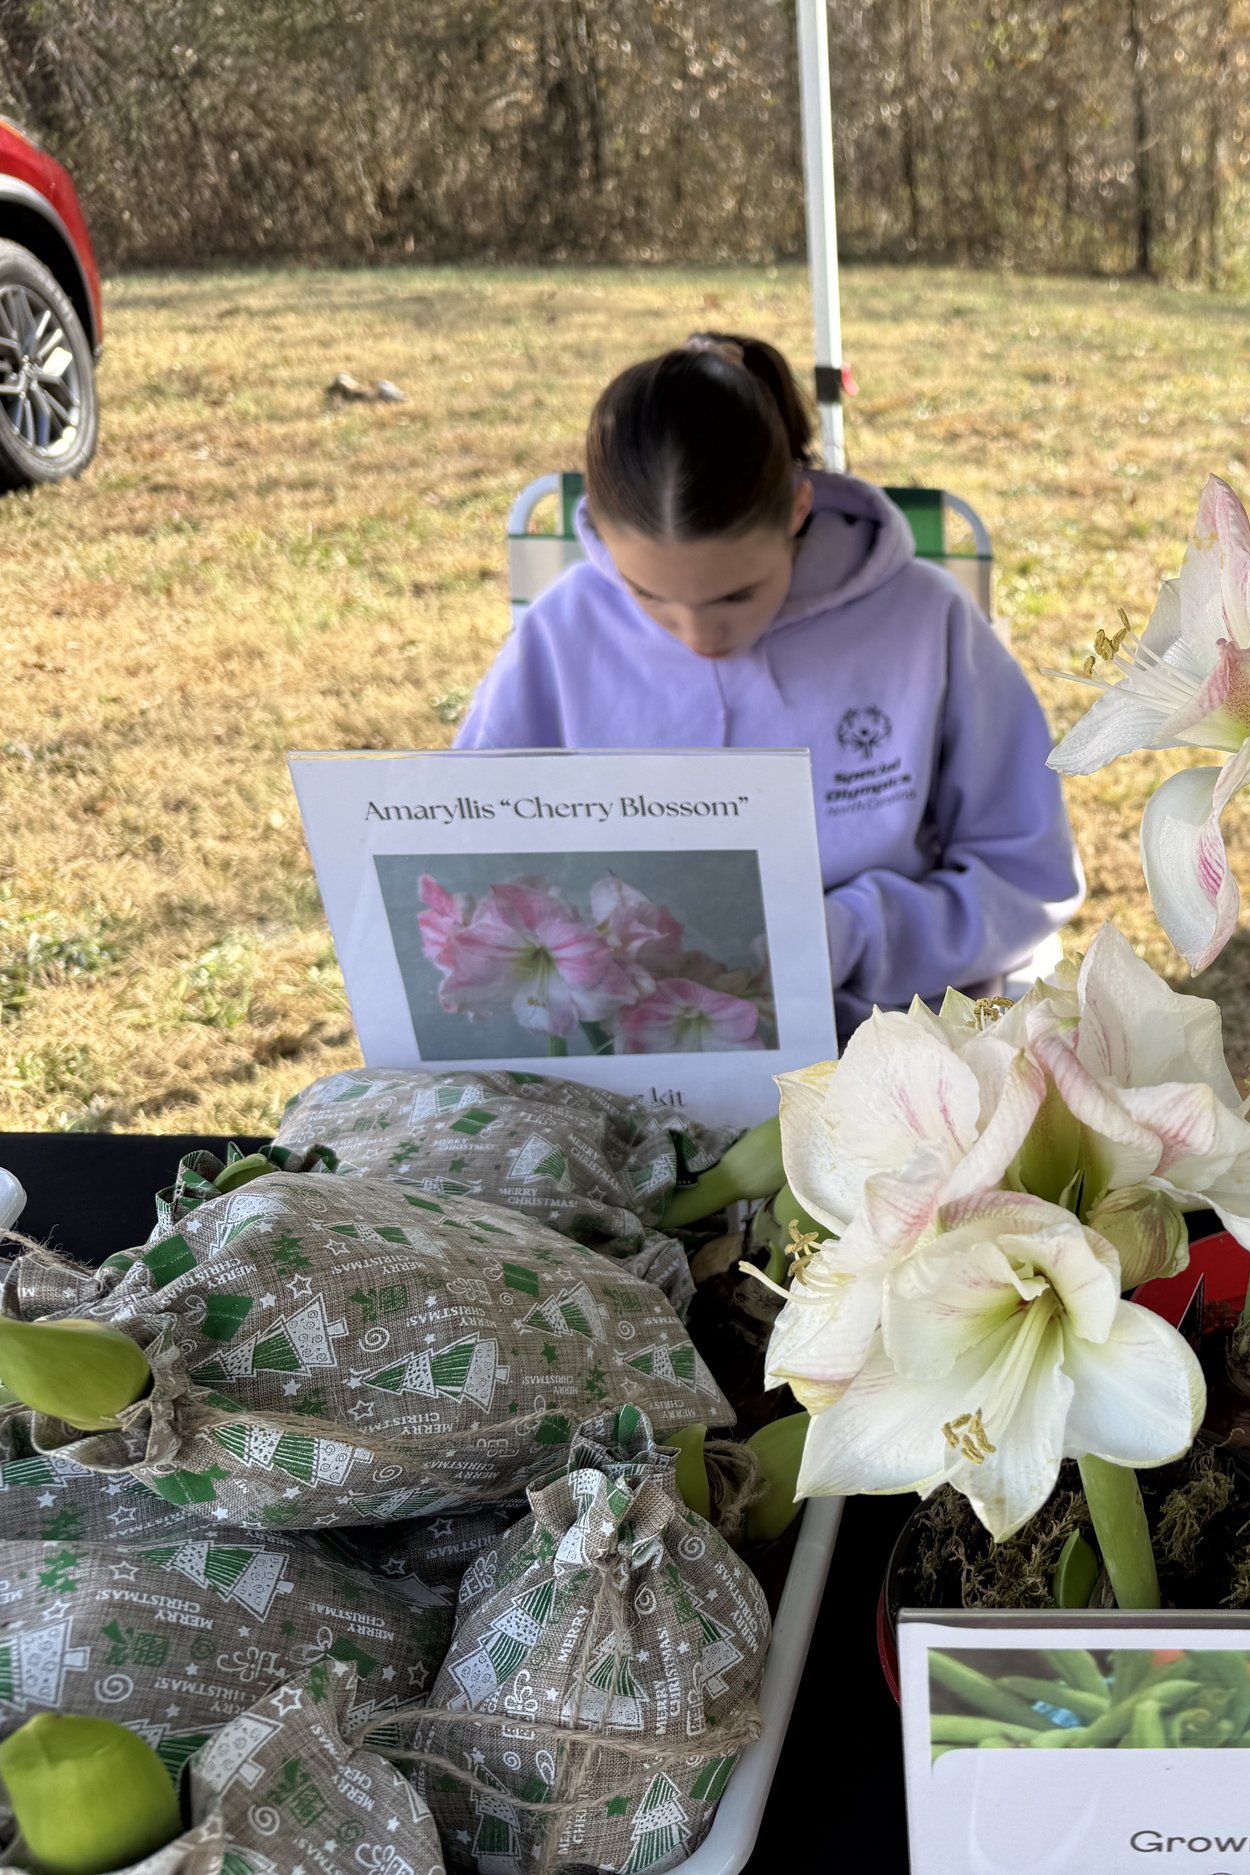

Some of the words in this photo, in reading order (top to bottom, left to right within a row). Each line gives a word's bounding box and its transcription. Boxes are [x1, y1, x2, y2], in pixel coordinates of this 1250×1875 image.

[366, 797, 495, 824] Amaryllis
[498, 1187, 539, 1198] MERRY
[507, 1196, 578, 1209] CHRISTMAS!
[331, 1254, 410, 1275] CHRISTMAS!
[382, 1260, 426, 1275] MERRY
[208, 1263, 258, 1290] MERRY
[405, 1306, 486, 1328] CHRISTMAS!
[459, 1315, 498, 1328] MERRY
[401, 1423, 452, 1436] MERRY
[96, 1589, 200, 1614] CHRISTMAS!
[154, 1609, 214, 1630] MERRY
[346, 1626, 395, 1641] MERRY
[557, 1604, 590, 1663] MERRY
[731, 1609, 759, 1654] MERRY
[656, 1627, 682, 1718] CHRISTMAS!
[653, 1680, 668, 1736] MERRY
